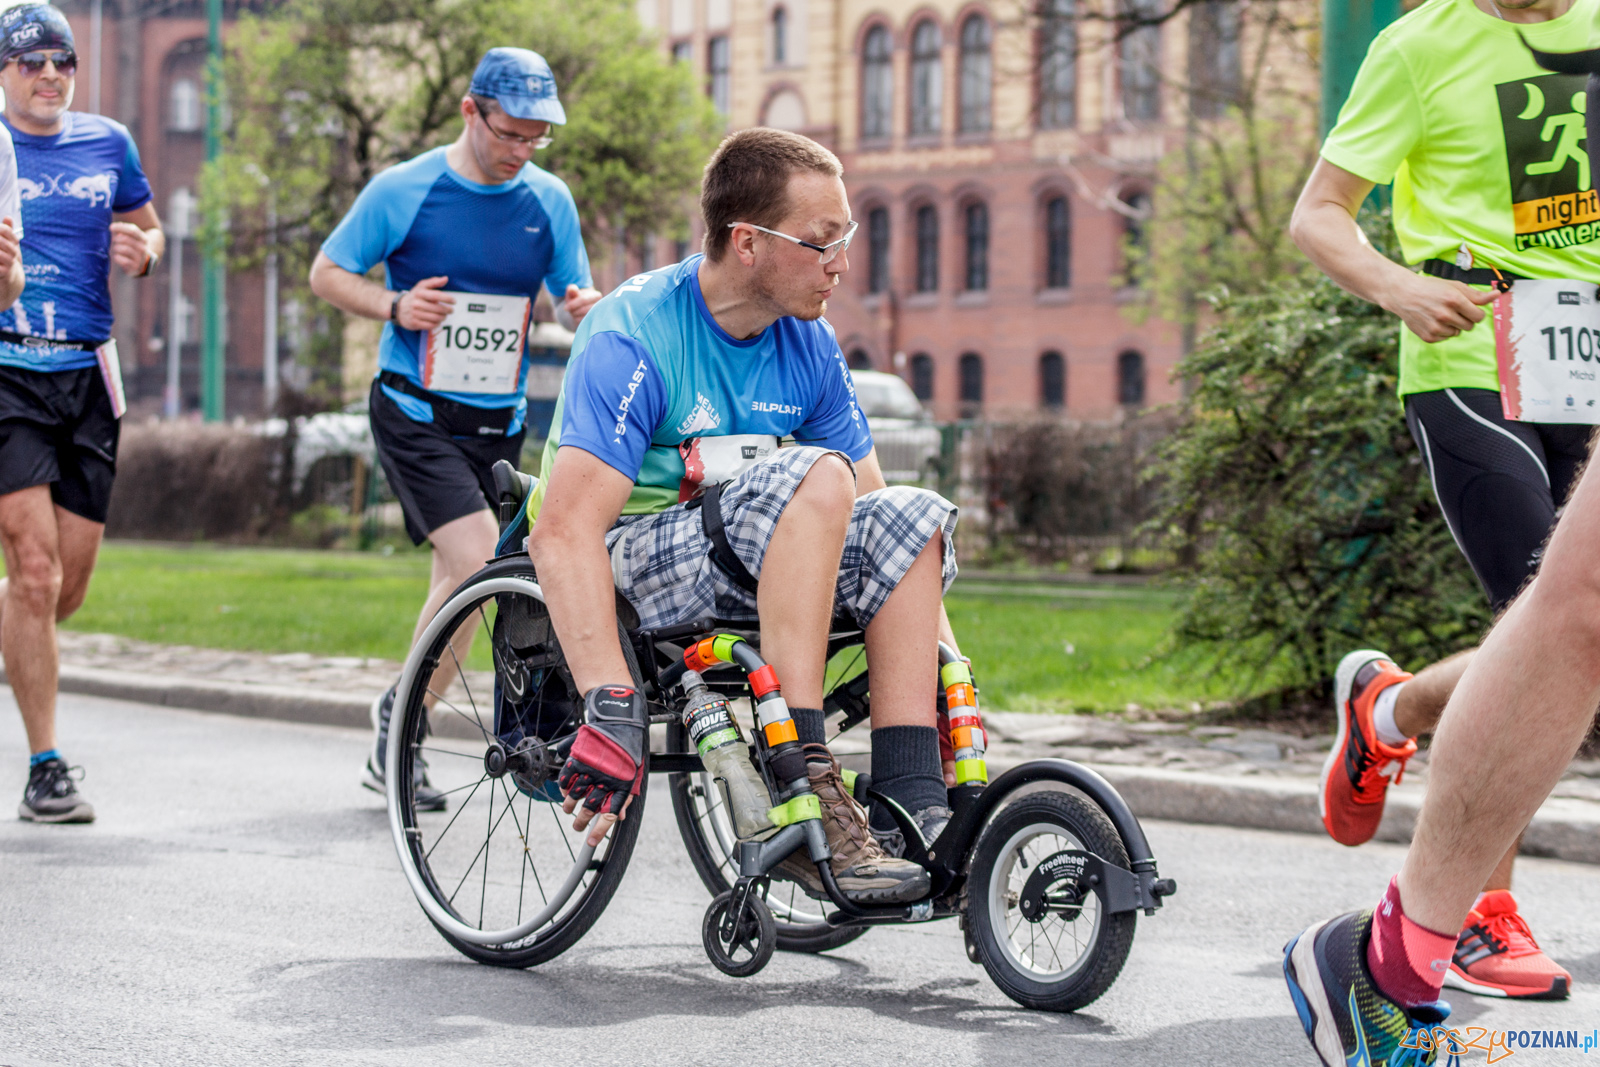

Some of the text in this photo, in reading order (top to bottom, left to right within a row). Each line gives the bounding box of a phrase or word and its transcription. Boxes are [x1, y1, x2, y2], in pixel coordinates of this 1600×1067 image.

[11, 27, 40, 44] TUT
[1537, 191, 1597, 225] night
[442, 325, 519, 352] 10592
[615, 359, 648, 436] SILPLAST
[751, 401, 803, 416] SILPLAST
